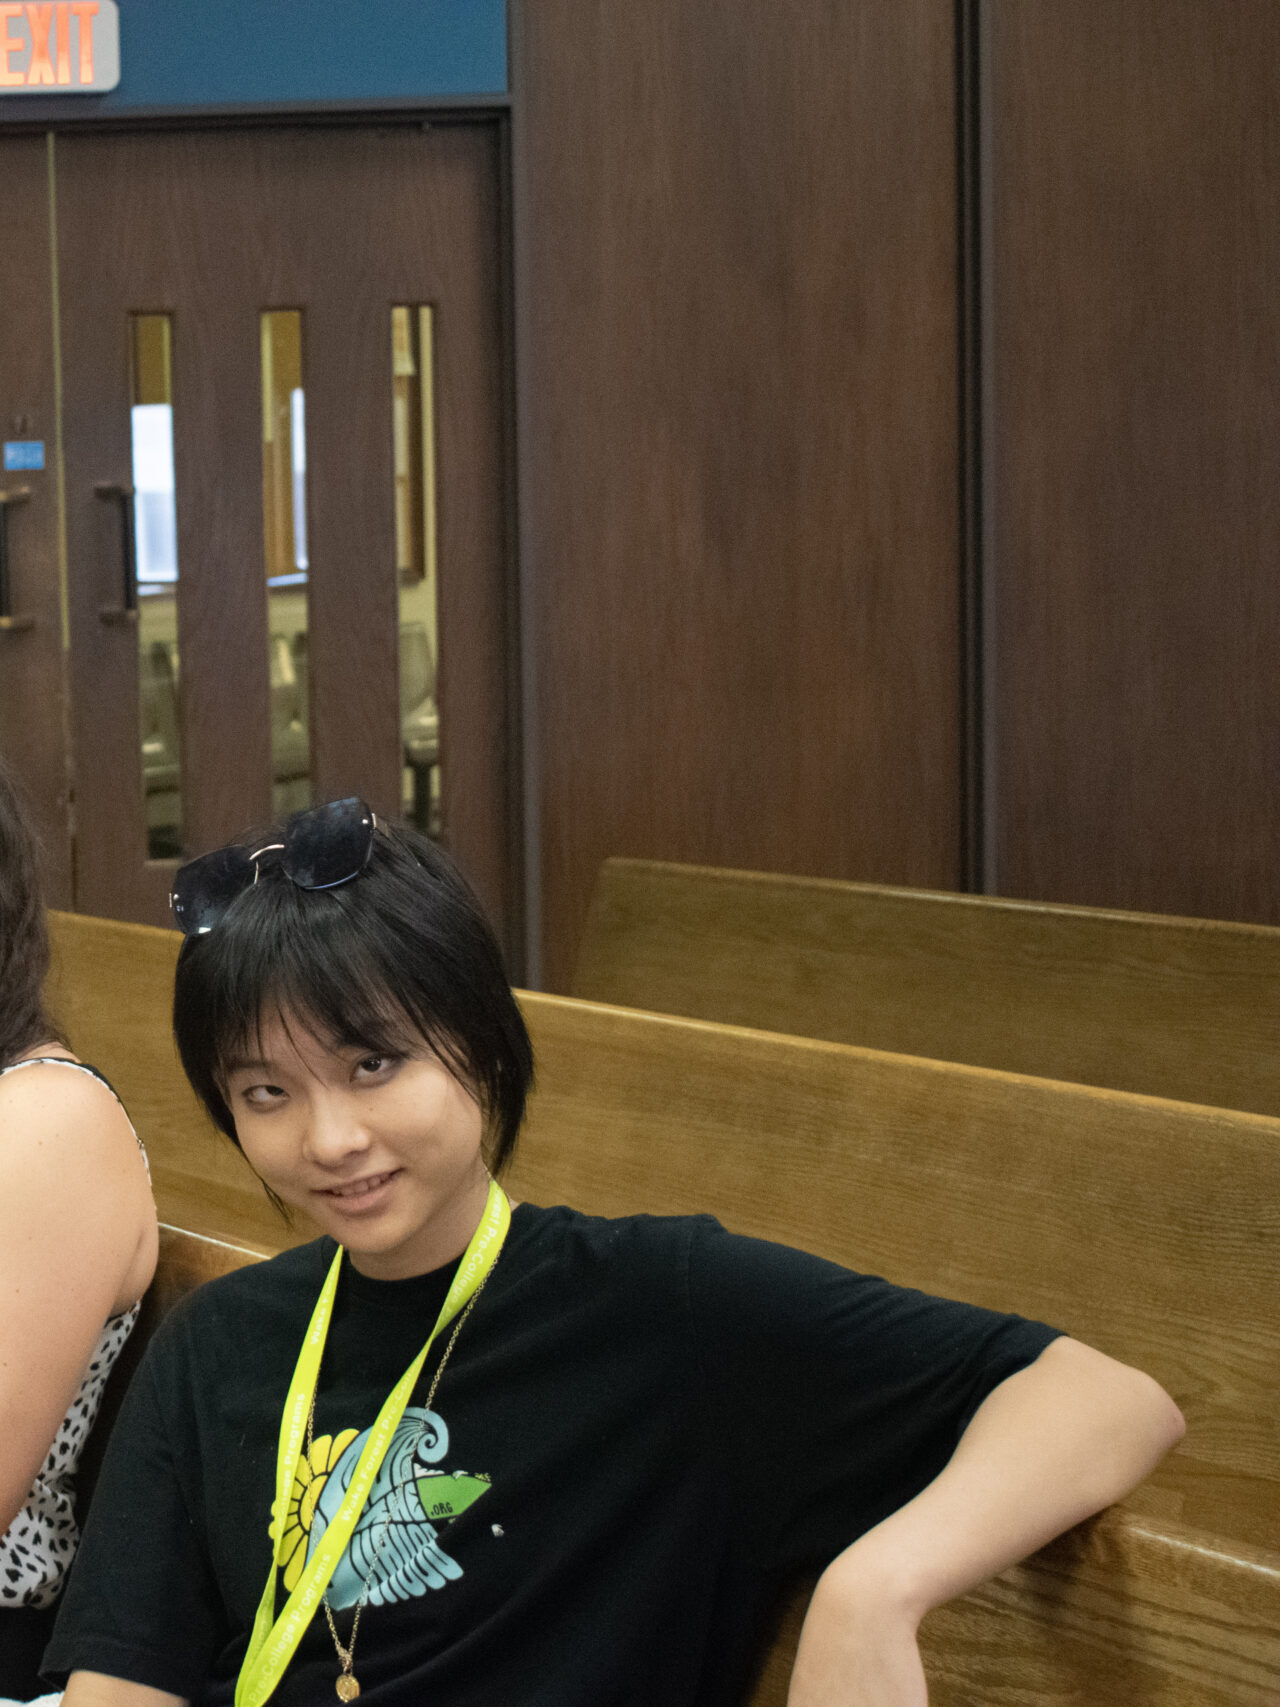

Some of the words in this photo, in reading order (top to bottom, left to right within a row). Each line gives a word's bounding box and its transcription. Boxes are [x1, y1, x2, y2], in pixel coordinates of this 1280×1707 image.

[284, 1393, 306, 1466] Programs
[341, 1482, 365, 1522] Wake
[360, 1432, 386, 1481] Forest
[430, 1502, 454, 1516] .ORG
[248, 1623, 296, 1703] Pre-College
[290, 1554, 332, 1623] Programs
